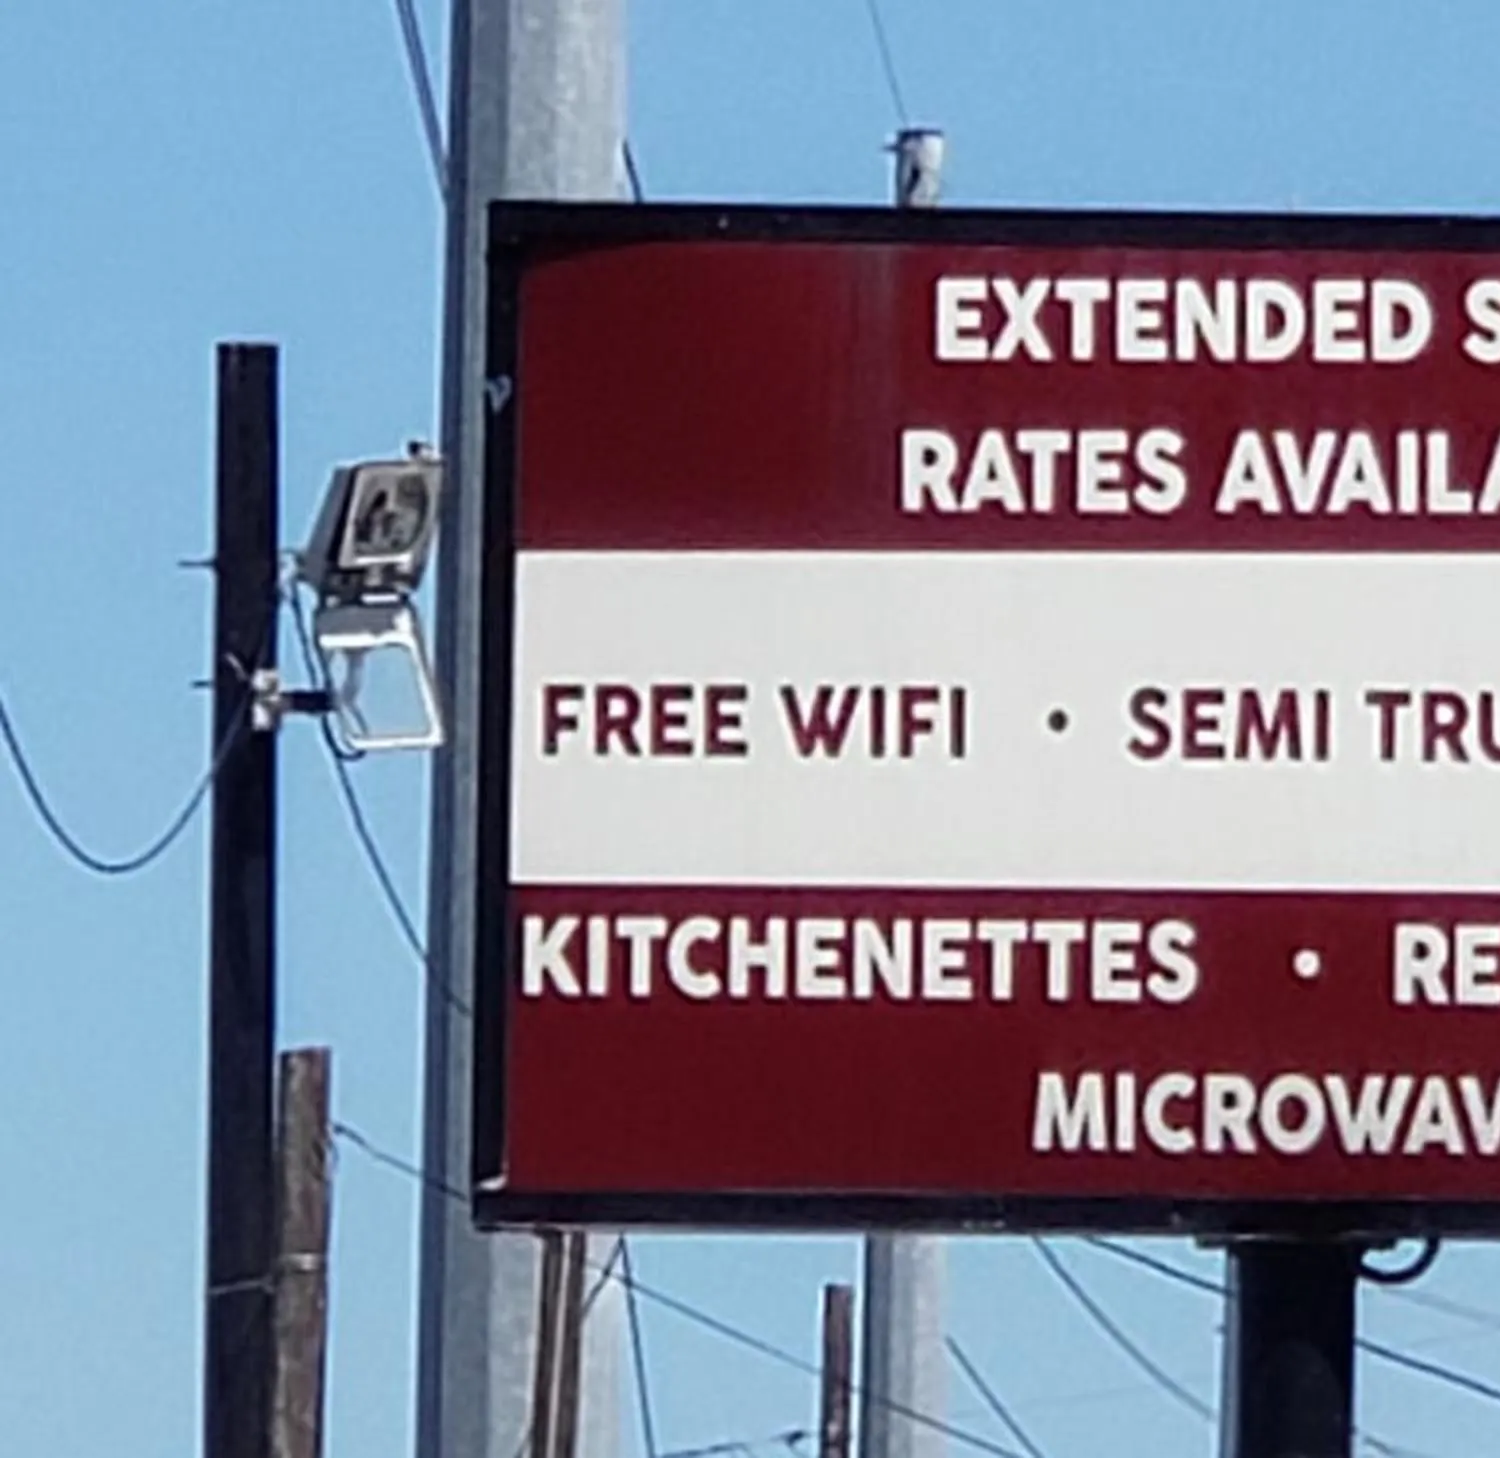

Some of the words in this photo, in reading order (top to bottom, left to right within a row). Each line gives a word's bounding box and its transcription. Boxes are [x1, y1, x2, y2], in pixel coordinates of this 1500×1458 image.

[936, 278, 1432, 362] EXTENDED
[902, 429, 1187, 513] RATES
[543, 684, 748, 757] FREE
[781, 685, 966, 758] WIFI
[1128, 688, 1330, 761] SEMI
[523, 916, 1199, 1002] KITCHENETTES
